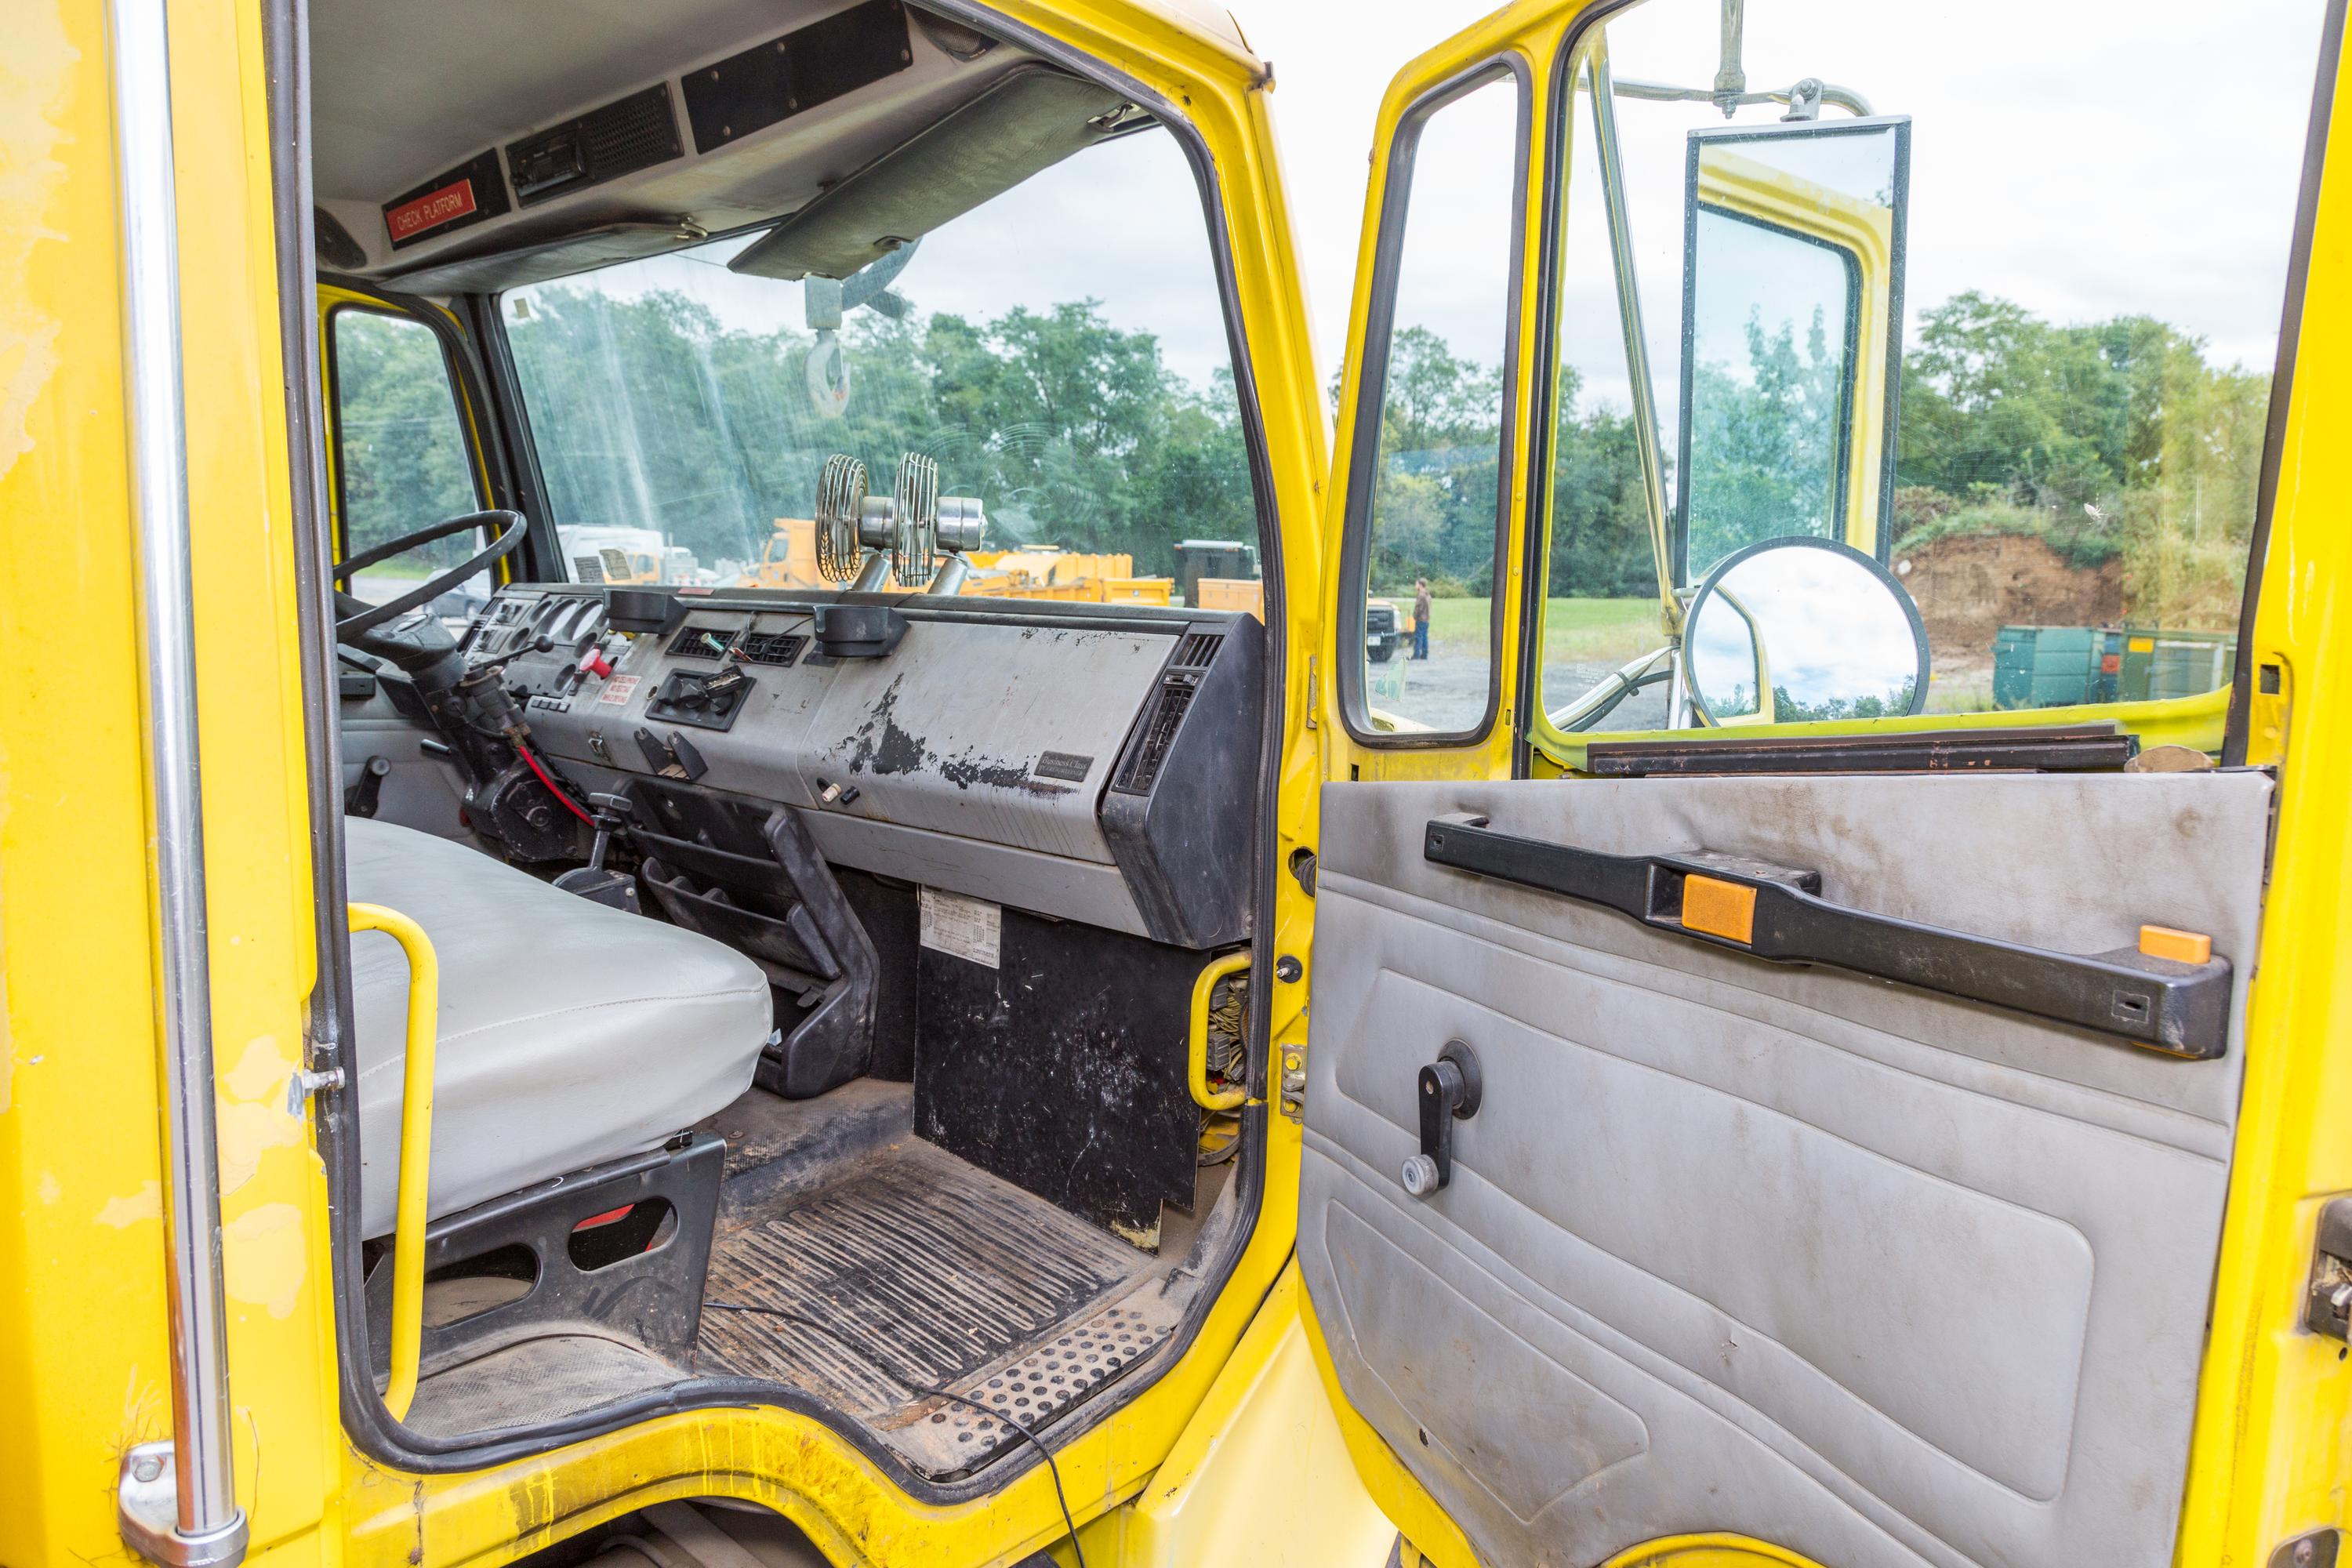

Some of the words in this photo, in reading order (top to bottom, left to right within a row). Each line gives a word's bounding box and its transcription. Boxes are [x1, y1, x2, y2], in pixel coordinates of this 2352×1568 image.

[397, 209, 423, 230] CHECK
[424, 192, 463, 219] PLATFORM
[1042, 757, 1069, 766] Business
[1069, 759, 1087, 770] Class
